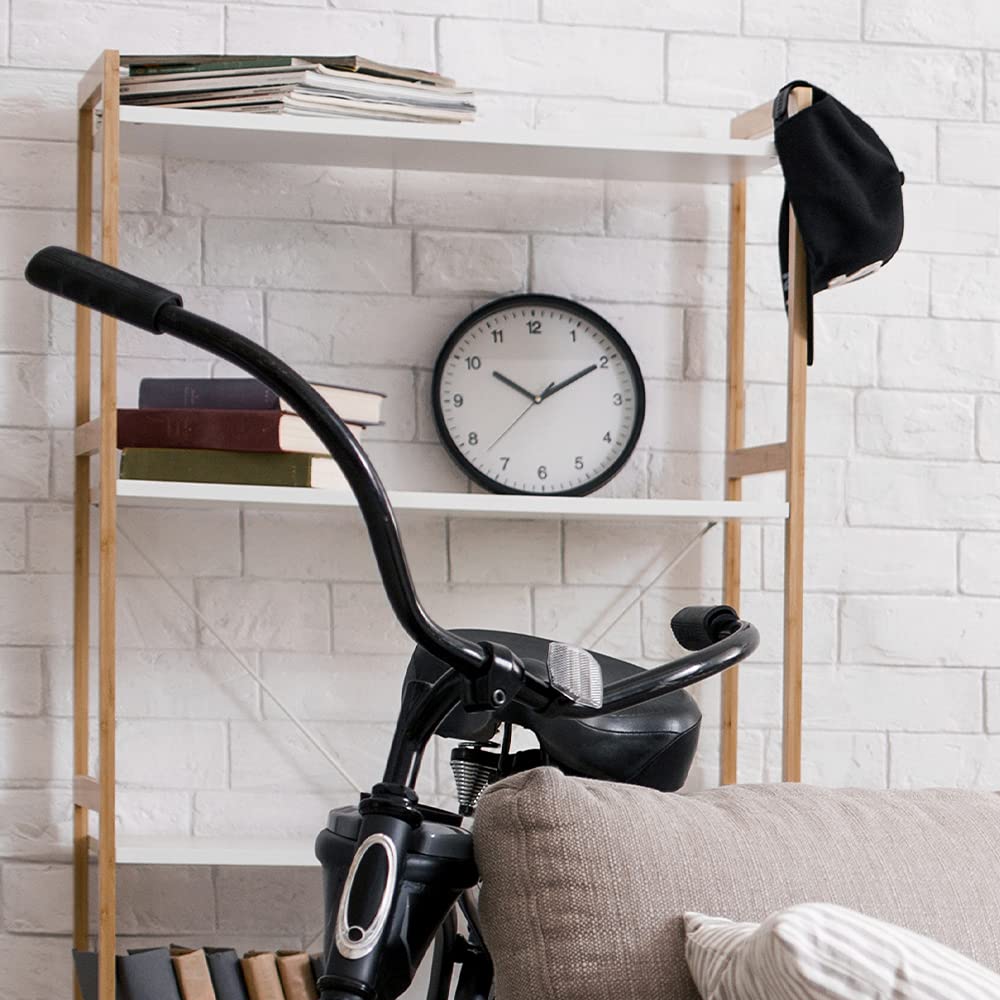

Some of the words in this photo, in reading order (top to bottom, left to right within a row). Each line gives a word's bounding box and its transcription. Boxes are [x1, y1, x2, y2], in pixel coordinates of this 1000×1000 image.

[526, 321, 542, 335] 12
[491, 330, 503, 343] 11
[570, 330, 577, 342] 1
[465, 356, 481, 370] 10
[599, 356, 609, 369] 2
[453, 394, 464, 407] 9
[612, 393, 623, 406] 3
[468, 432, 478, 445] 8
[603, 432, 612, 443] 4
[499, 457, 510, 470] 7
[574, 456, 584, 470] 5
[537, 466, 548, 479] 6
